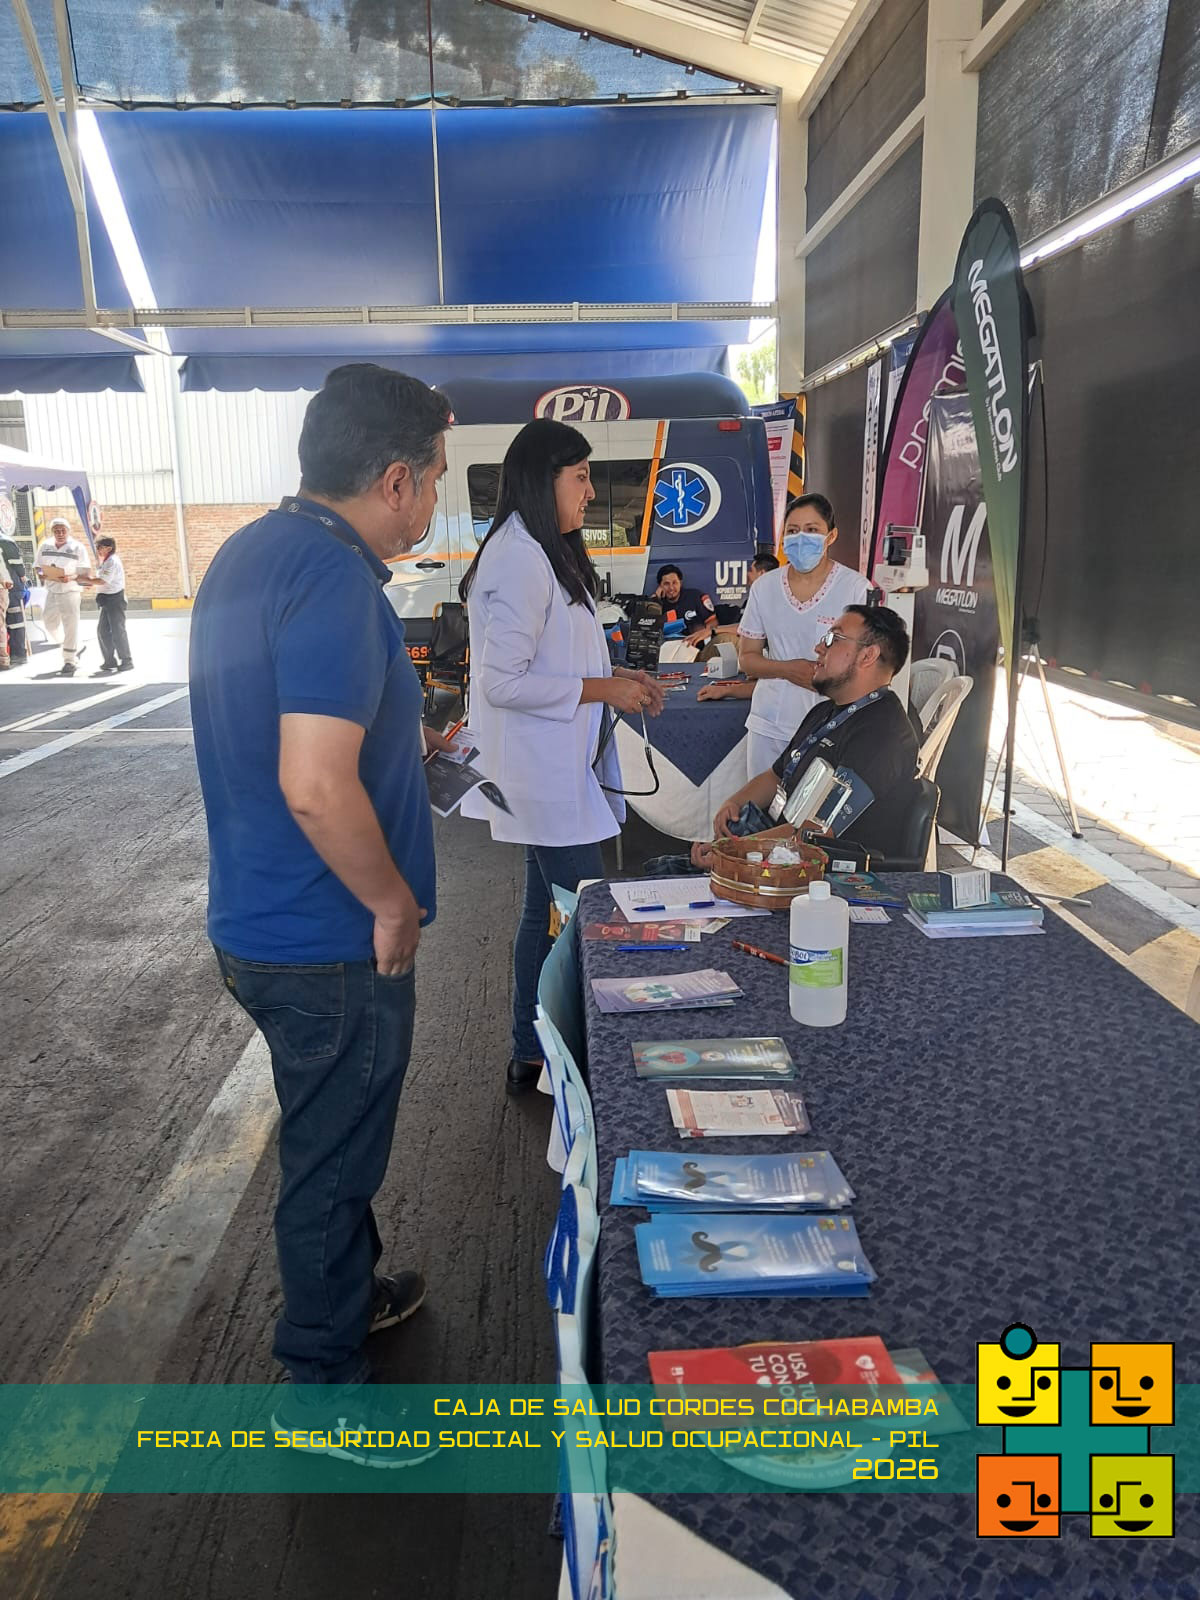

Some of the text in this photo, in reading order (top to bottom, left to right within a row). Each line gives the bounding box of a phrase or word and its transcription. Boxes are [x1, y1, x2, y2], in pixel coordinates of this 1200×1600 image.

[968, 259, 1018, 474] MEGATLON
[552, 387, 611, 421] Pil
[582, 529, 608, 541] SIVOS
[940, 501, 987, 587] M
[715, 560, 748, 586] UTI
[935, 588, 979, 609] MEGATLON
[748, 1355, 768, 1374] TU
[787, 1352, 810, 1381] USA
